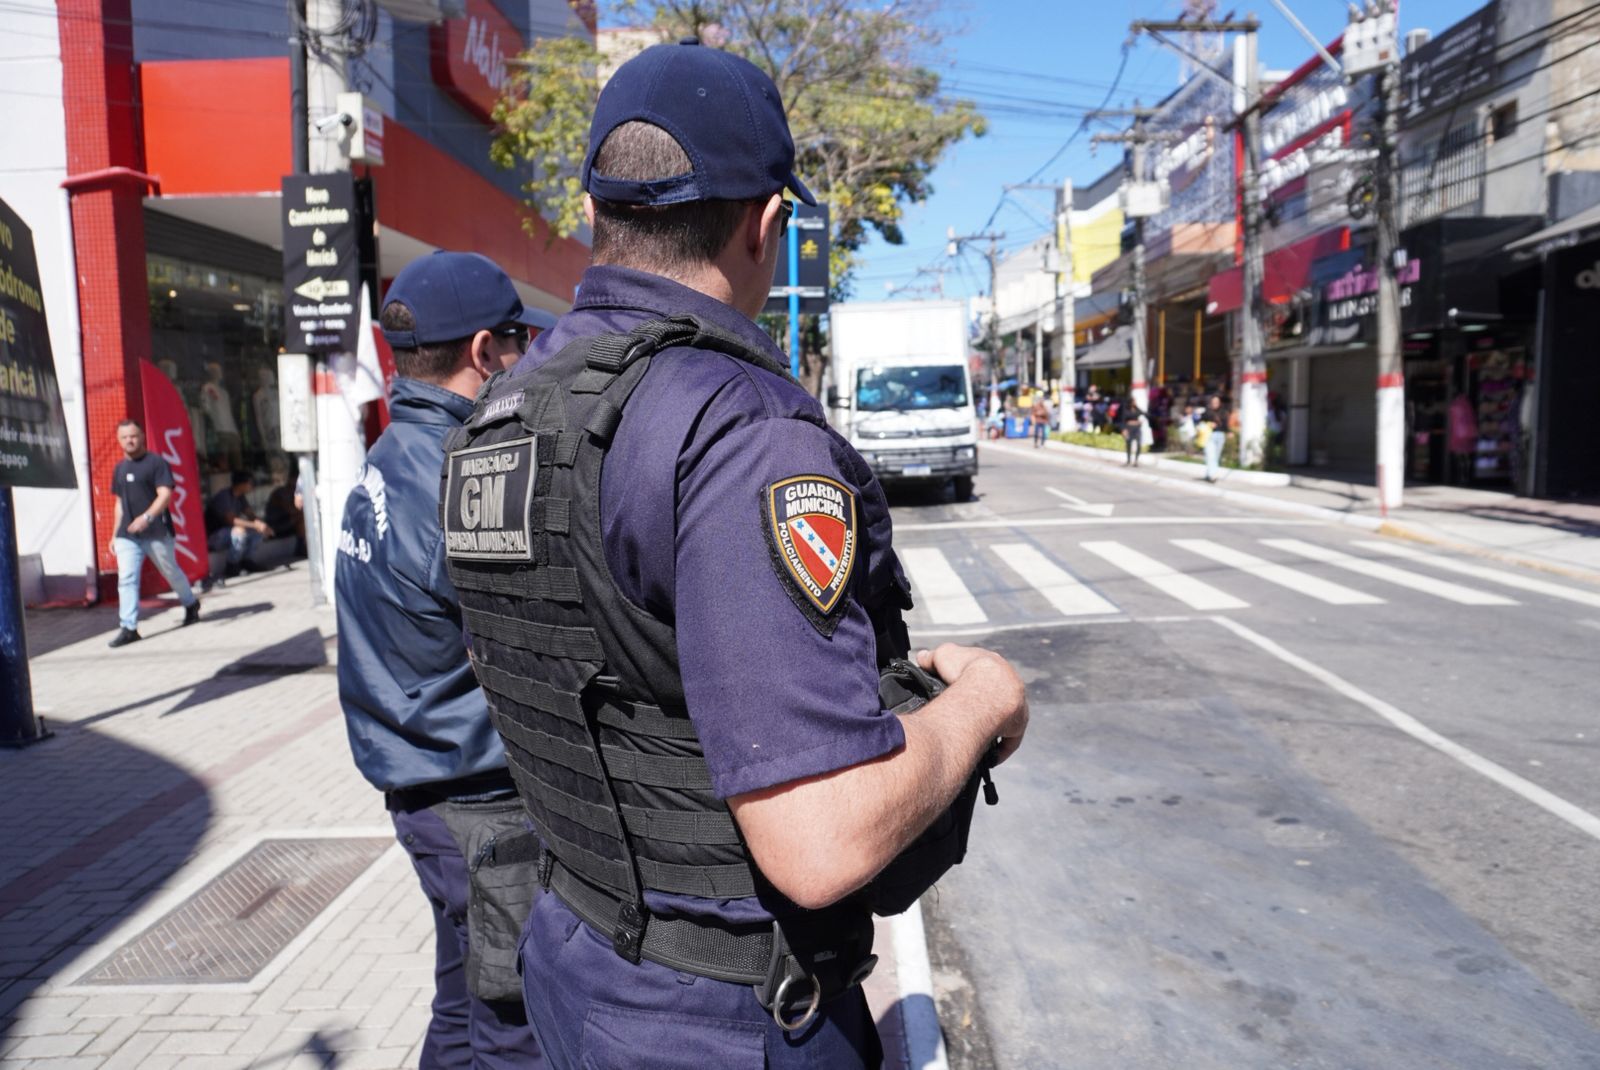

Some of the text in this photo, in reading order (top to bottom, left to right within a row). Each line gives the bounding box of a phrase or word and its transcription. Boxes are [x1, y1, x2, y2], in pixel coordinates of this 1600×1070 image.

[460, 474, 506, 531] GM
[785, 483, 845, 507] GUARDA
[786, 498, 847, 522] MUNICIPAL
[478, 530, 527, 552] MUNICIPAL
[778, 522, 822, 597] POLICIAMENTO
[829, 529, 853, 591] PREVENTIVO
